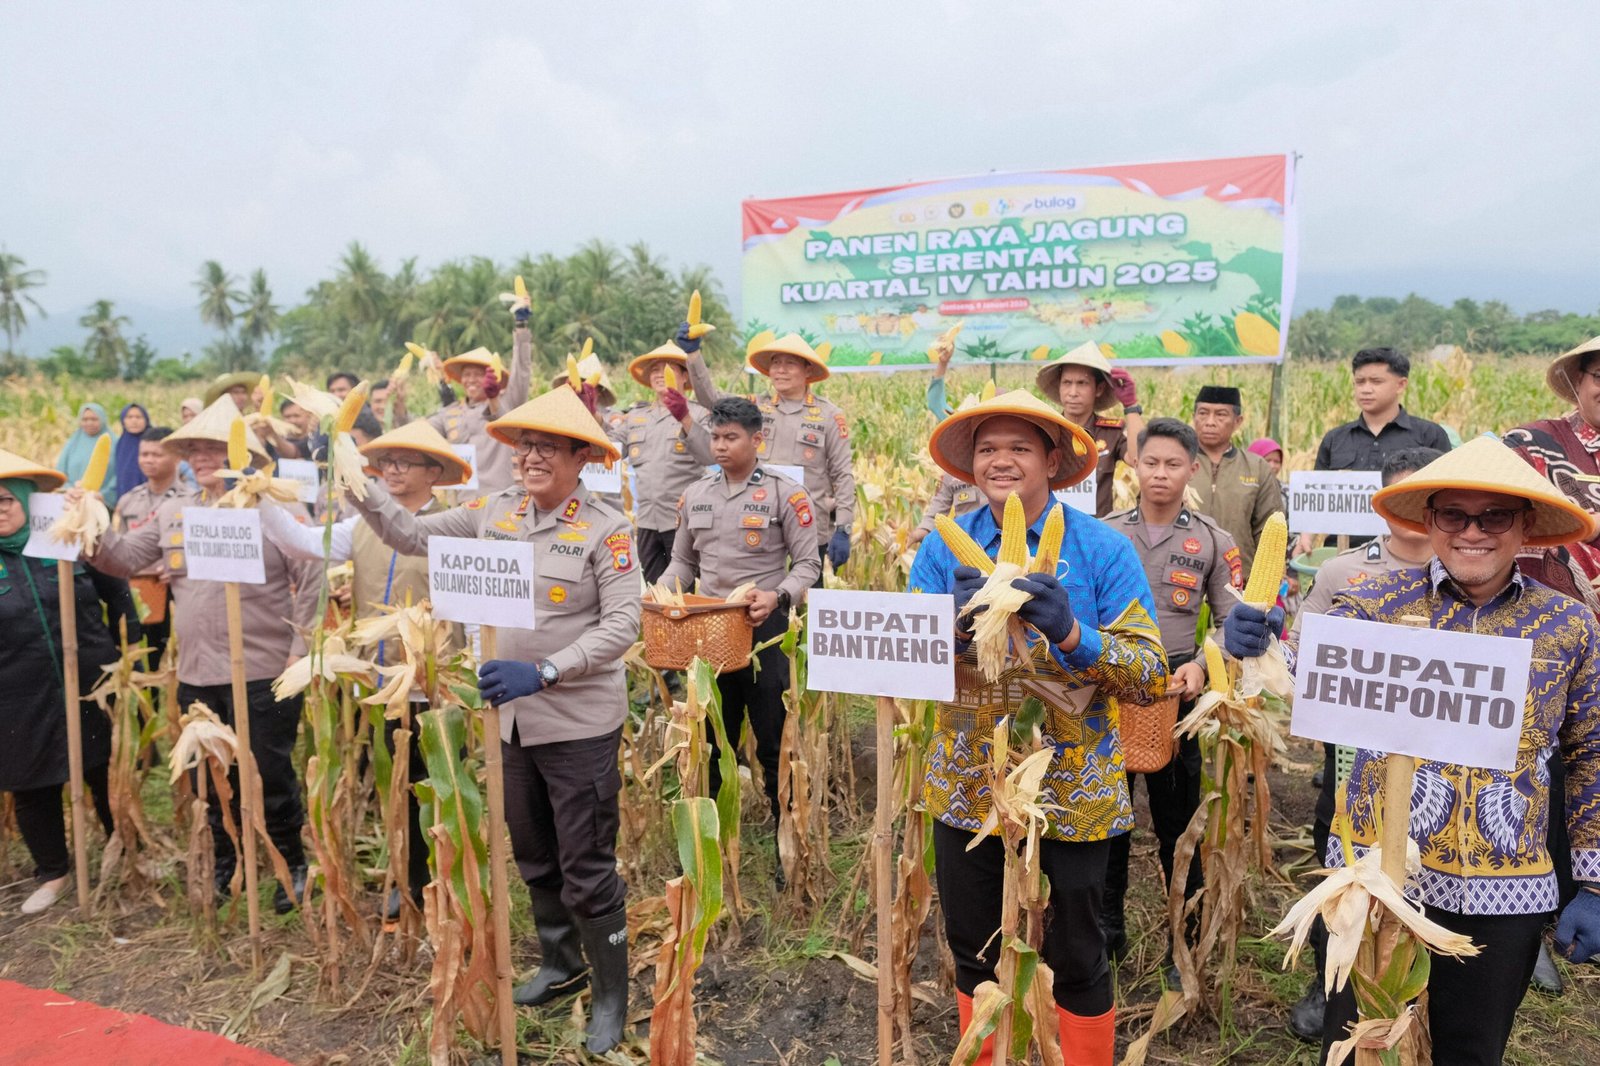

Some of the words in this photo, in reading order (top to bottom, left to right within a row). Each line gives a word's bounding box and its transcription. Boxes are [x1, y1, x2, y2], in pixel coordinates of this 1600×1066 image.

[1034, 196, 1076, 210] bulog
[805, 232, 917, 260] PANEN
[926, 225, 1020, 251] RAYA
[1029, 213, 1186, 243] JAGUNG
[891, 245, 1080, 275] SERENTAK
[782, 278, 929, 304] KUARTAL
[937, 274, 975, 295] IV
[983, 266, 1105, 292] TAHUN
[1115, 260, 1219, 286] 2025
[1304, 483, 1379, 491] KETUA
[743, 503, 770, 513] POLRI
[1293, 492, 1325, 512] DPRD
[1328, 493, 1376, 514] BANTAE
[189, 524, 220, 539] KEPALA
[221, 525, 252, 540] BULOG
[549, 543, 584, 557] POLRI
[440, 553, 521, 575] KAPOLDA
[1169, 554, 1205, 571] POLRI
[433, 571, 482, 596] SULAWESI
[485, 576, 530, 600] SELATAN
[818, 609, 939, 635] BUPATI
[812, 632, 949, 665] BANTAENG
[1315, 643, 1507, 692] BUPATI
[1302, 671, 1516, 729] JENEPONTO
